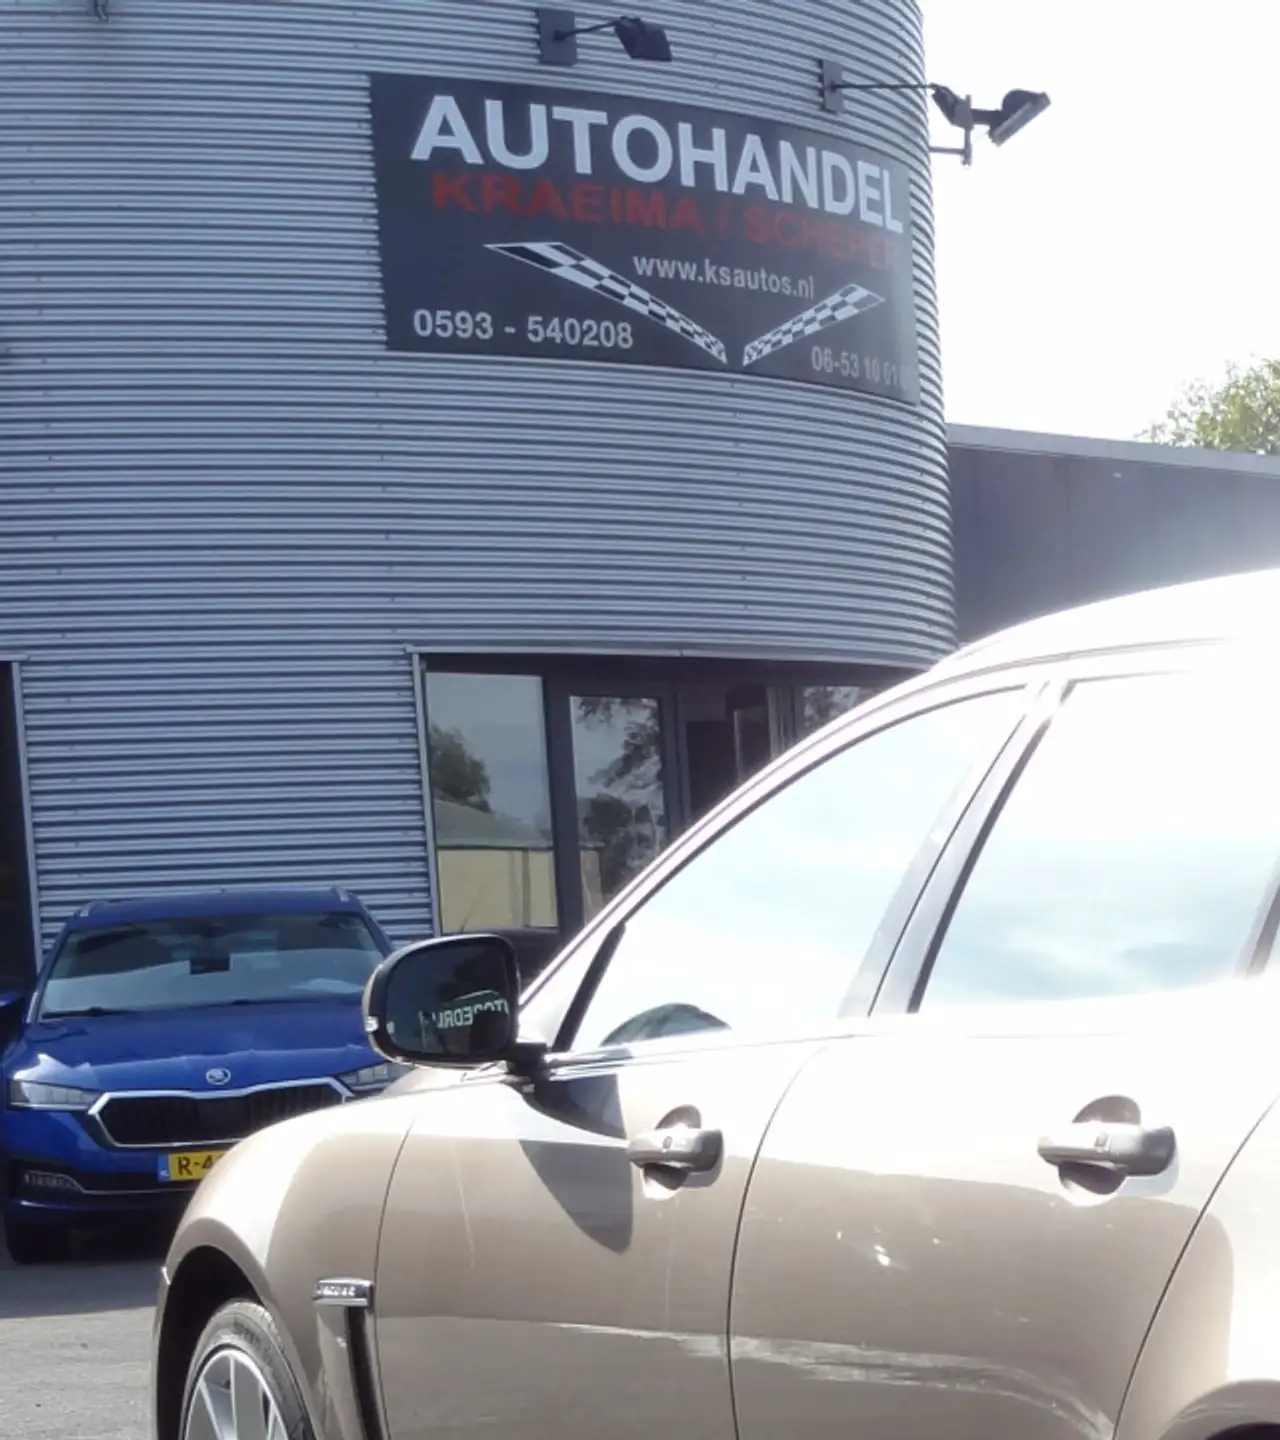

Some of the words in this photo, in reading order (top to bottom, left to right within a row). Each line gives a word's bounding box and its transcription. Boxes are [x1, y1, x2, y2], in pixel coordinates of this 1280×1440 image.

[410, 94, 905, 236] AUTOHANDEL
[431, 169, 708, 234] KRAEIMA
[633, 256, 815, 299] www.ksautos.nl
[413, 309, 493, 340] 0593
[527, 316, 634, 349] 540208
[811, 346, 859, 379] 06-53
